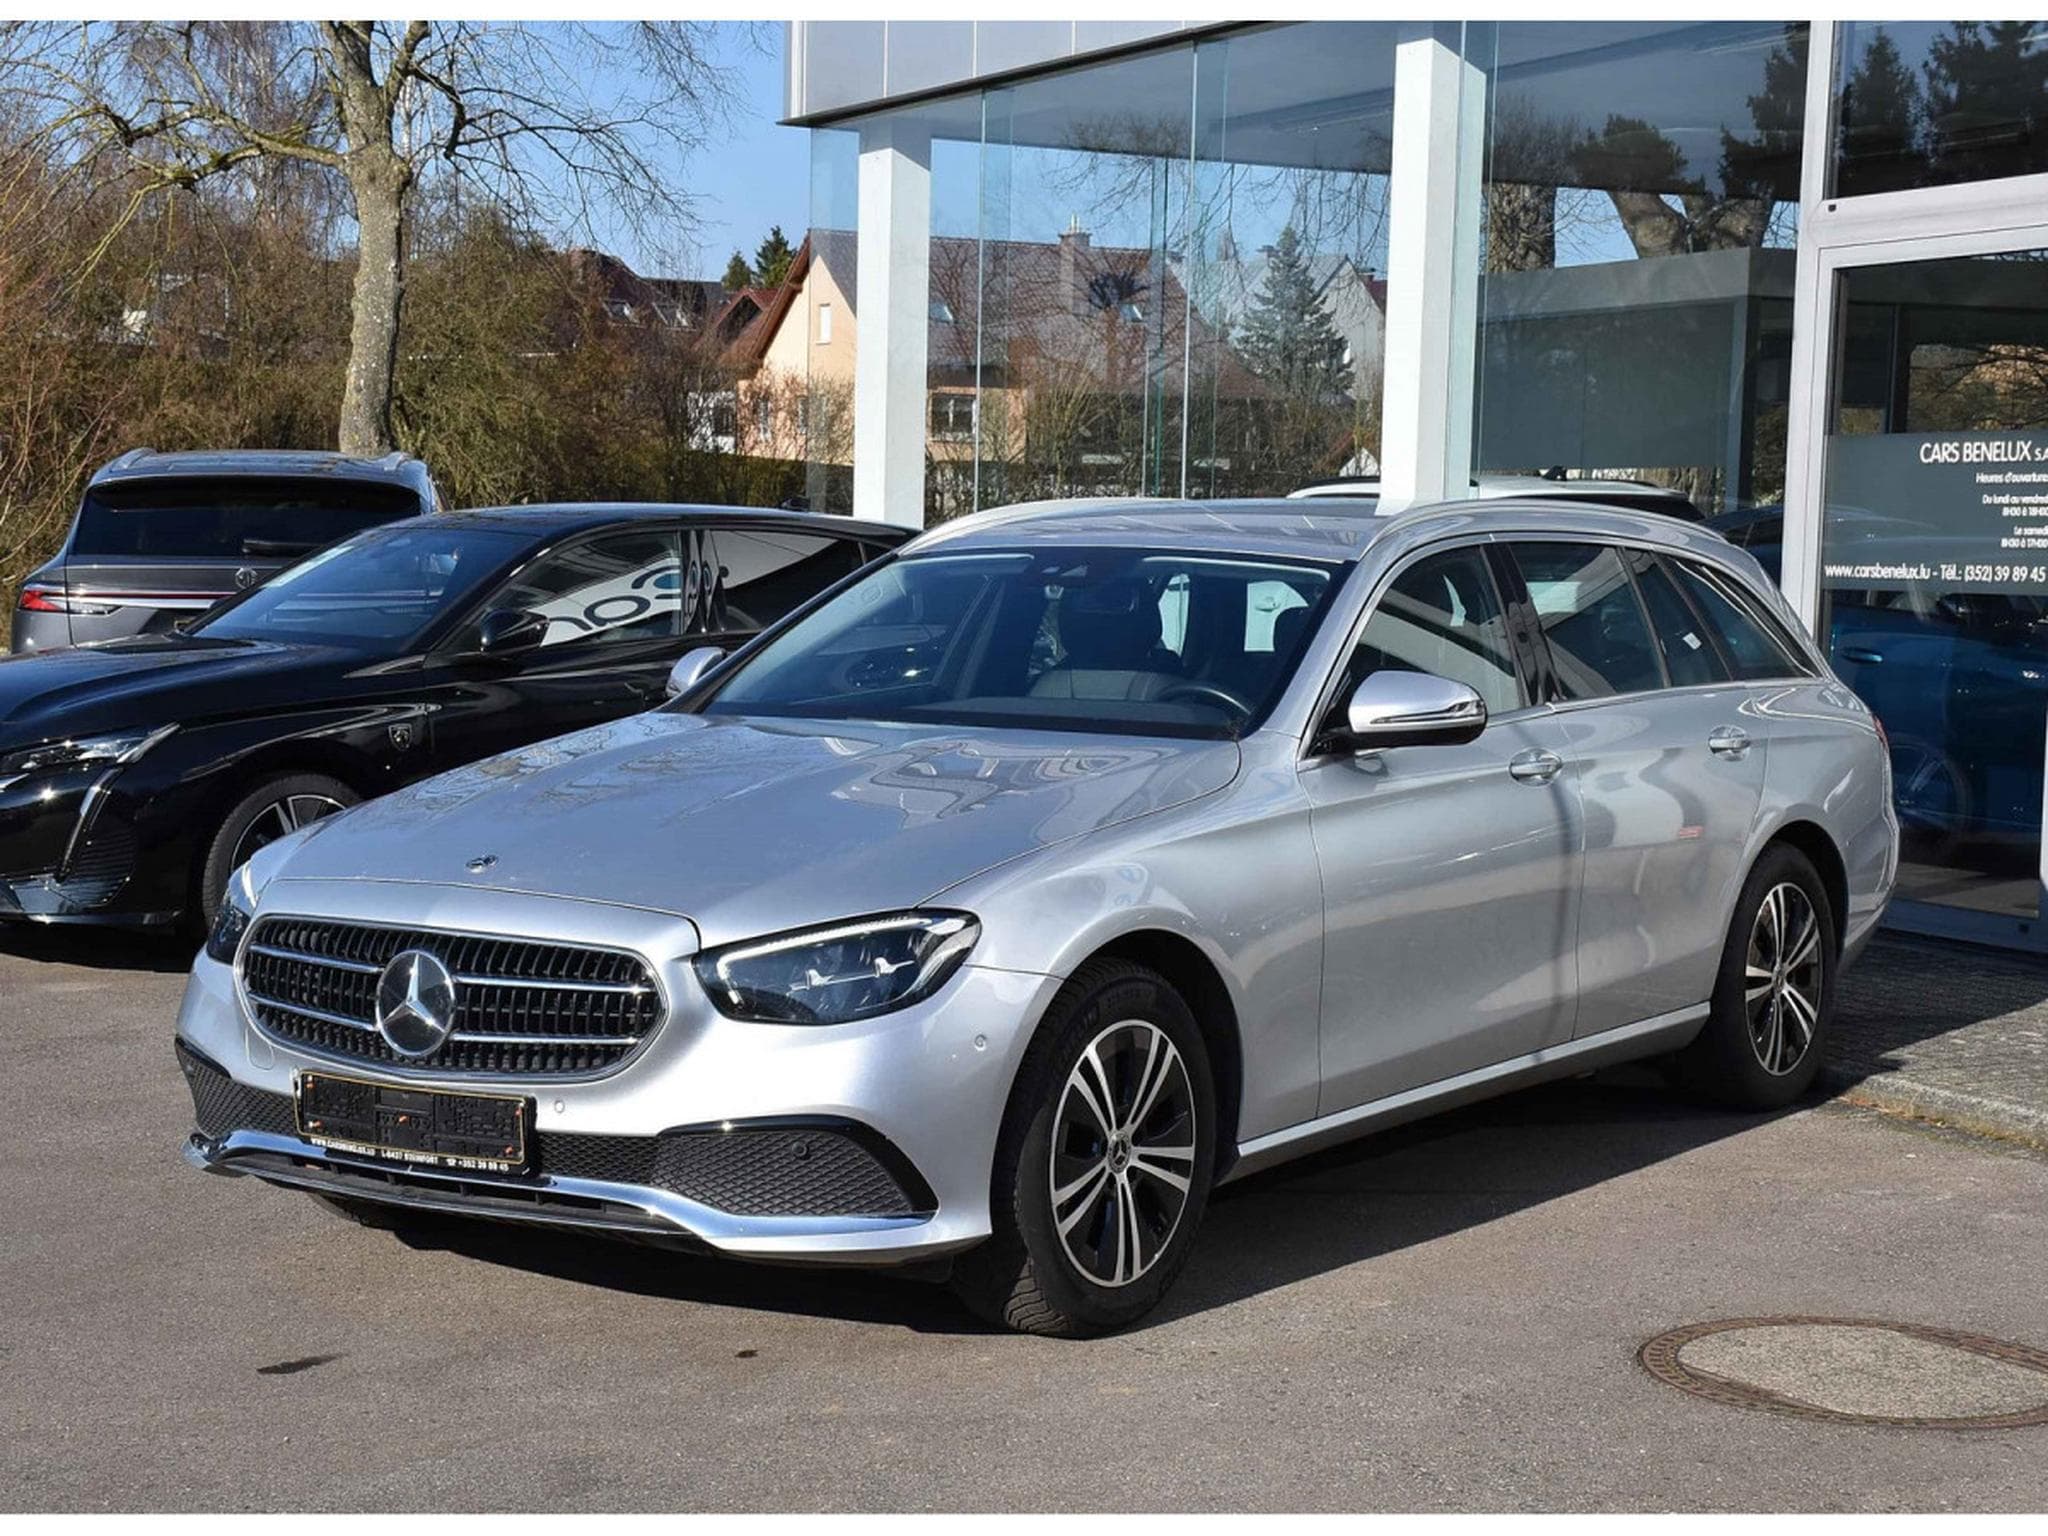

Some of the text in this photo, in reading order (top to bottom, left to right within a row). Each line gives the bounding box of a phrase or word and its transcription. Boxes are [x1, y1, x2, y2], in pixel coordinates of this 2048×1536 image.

[1920, 442, 1960, 463] CARS
[1962, 440, 2032, 463] BENELUX
[1975, 472, 2004, 484] Heures
[1982, 494, 1992, 504] Du
[1824, 562, 1931, 580] www.carsbenelux.lu
[1964, 564, 1992, 582] (352)
[1994, 565, 2010, 582] 39
[2012, 565, 2028, 582] 89
[2030, 566, 2046, 583] 45
